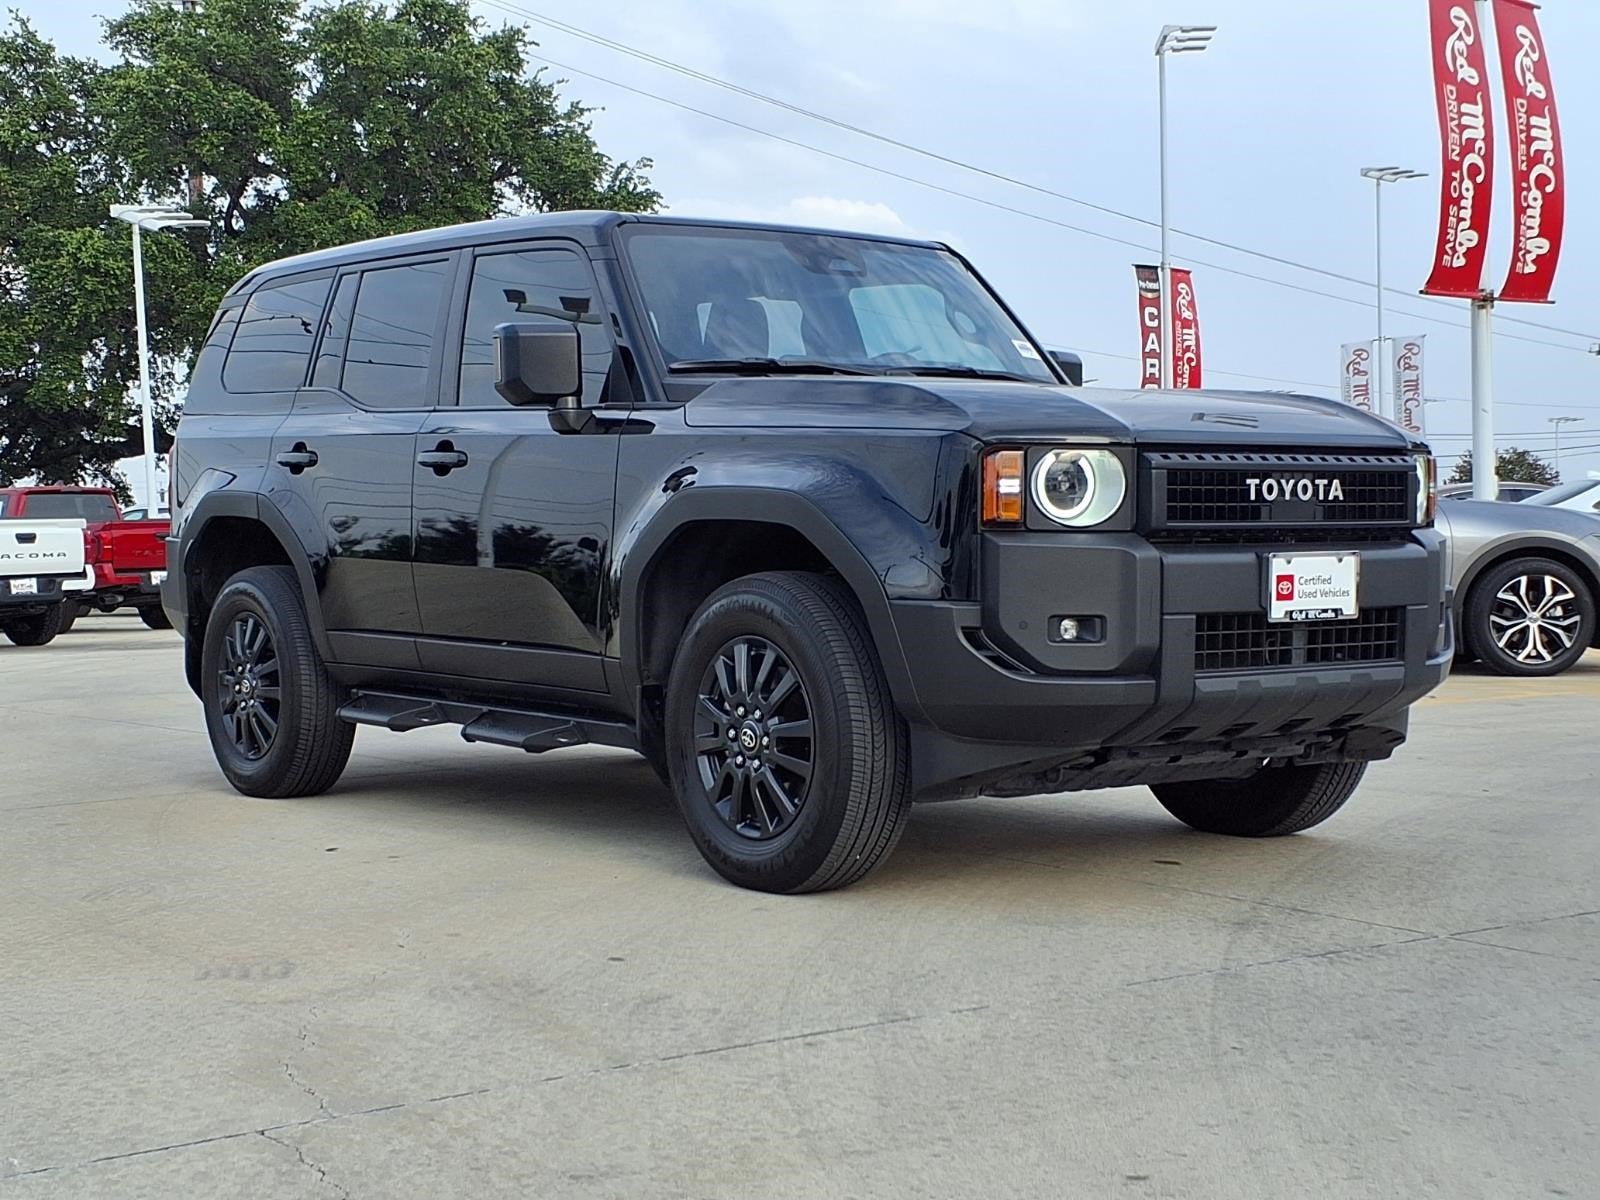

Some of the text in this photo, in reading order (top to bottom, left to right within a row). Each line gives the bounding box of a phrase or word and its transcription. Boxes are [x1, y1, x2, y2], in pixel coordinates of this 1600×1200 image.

[1446, 5, 1480, 87] Red
[1515, 24, 1547, 100] Red
[1516, 98, 1528, 171] DRIVEN
[1442, 84, 1461, 268] DRIVEN TO SERVE
[1516, 213, 1527, 274] SERVE
[1176, 281, 1196, 389] Red McCom
[1397, 342, 1421, 372] Red
[1346, 348, 1370, 377] Red
[1245, 478, 1344, 501] TOYOTA
[0, 551, 67, 560] ACOMA
[1298, 576, 1332, 586] Certified
[1298, 588, 1350, 599] Used Vehicles
